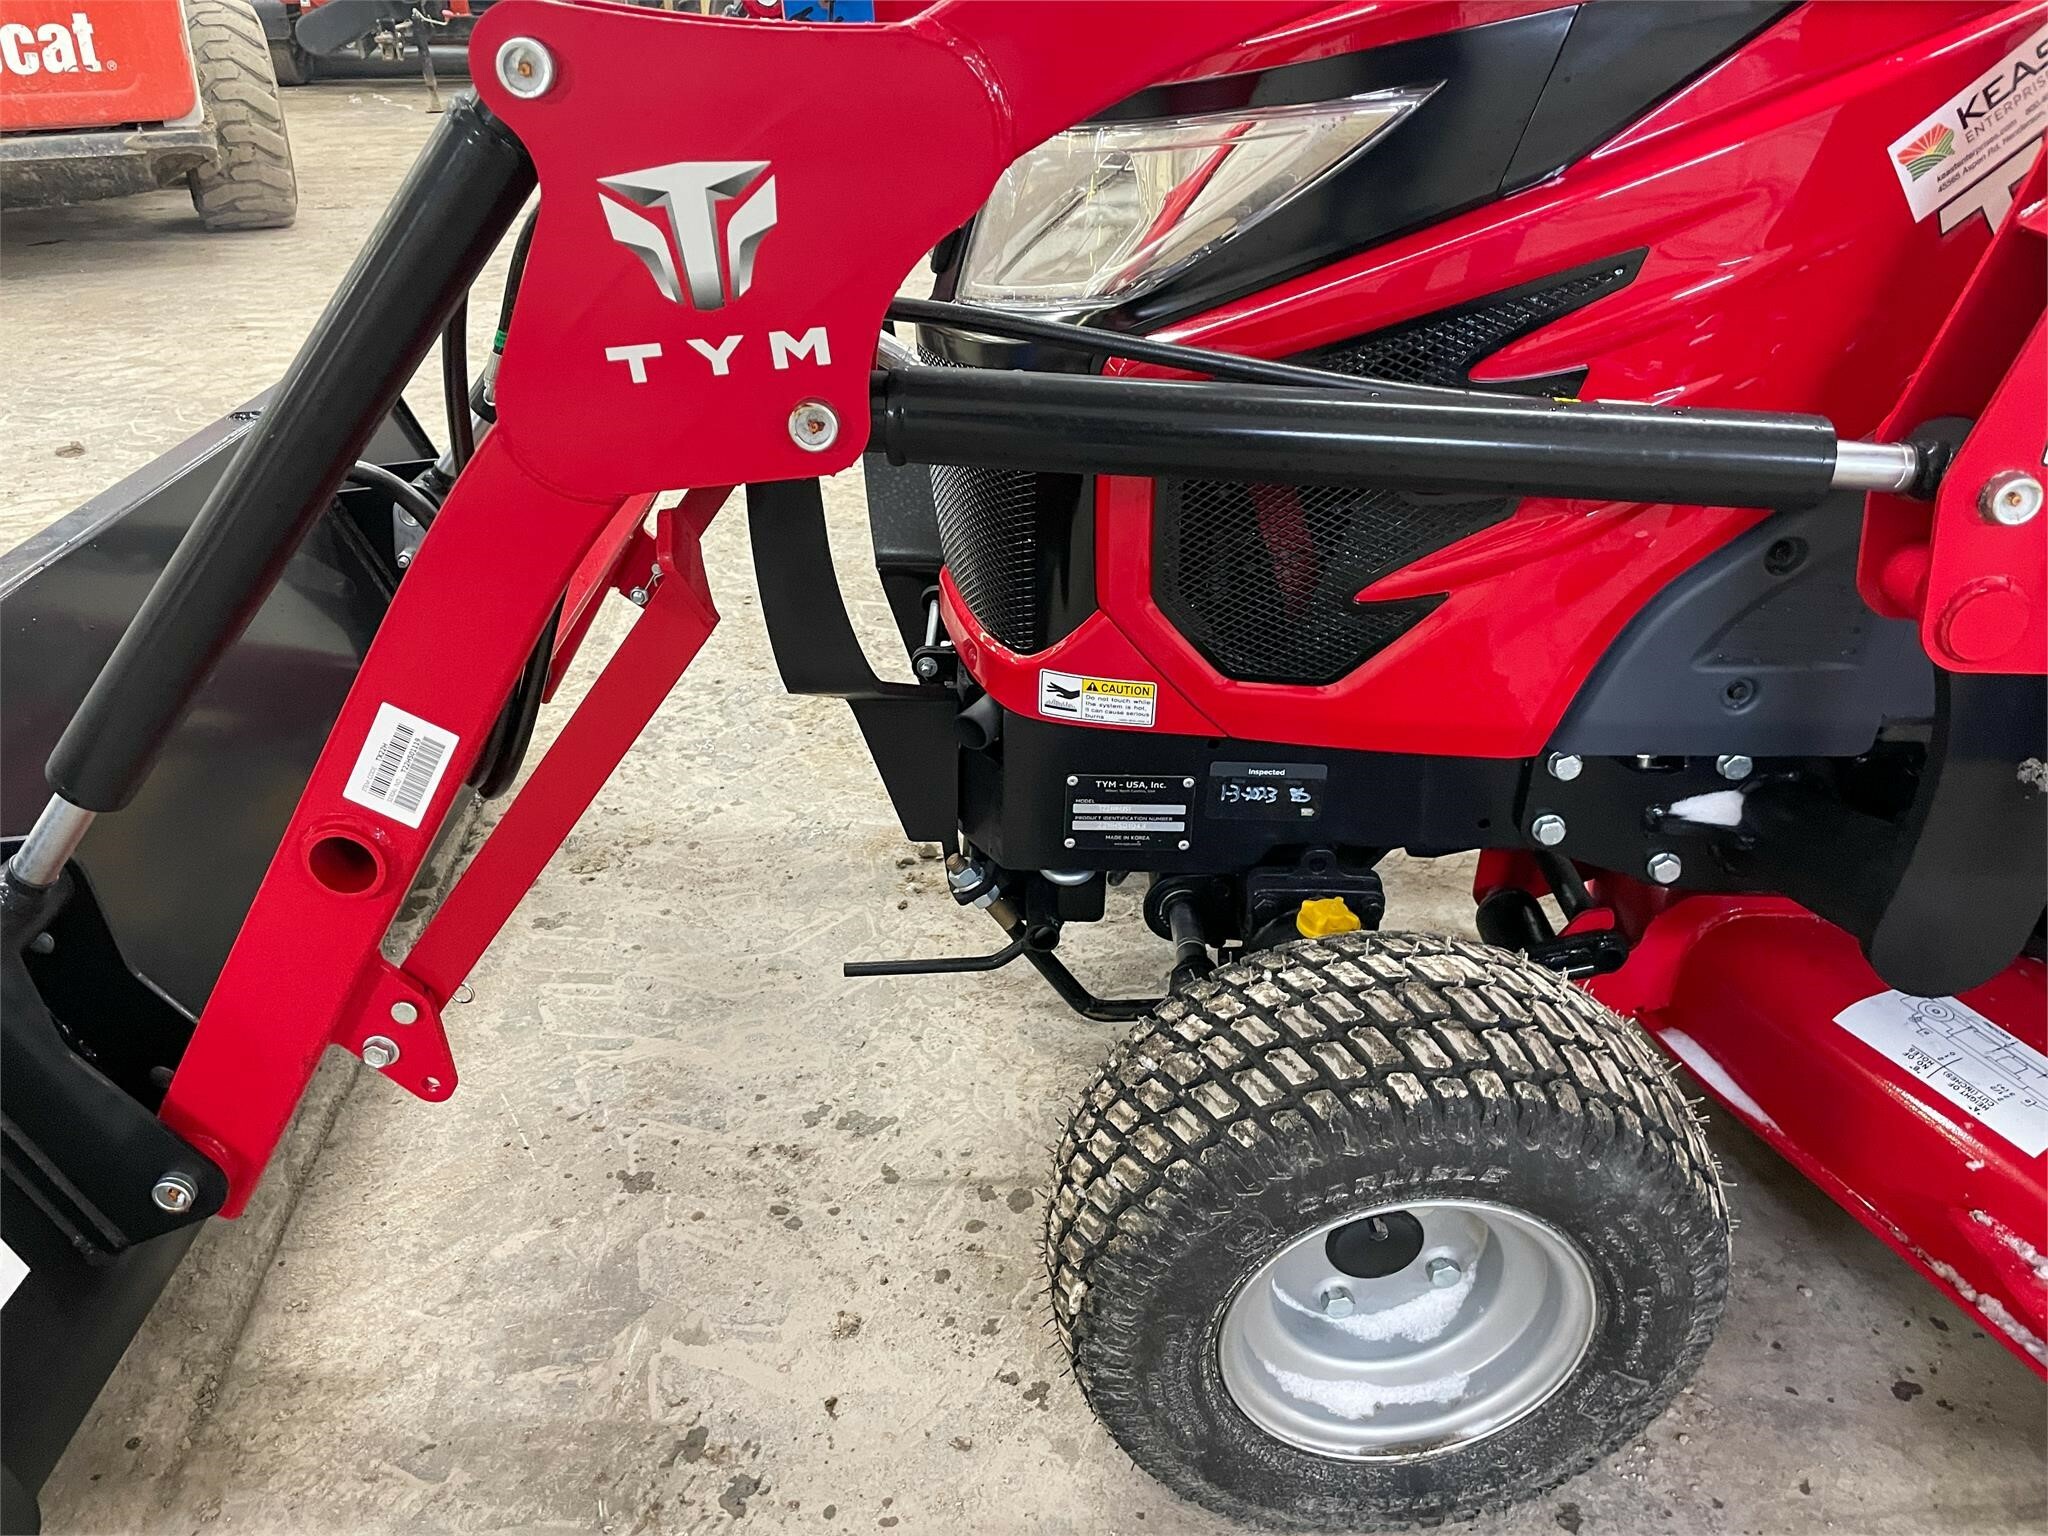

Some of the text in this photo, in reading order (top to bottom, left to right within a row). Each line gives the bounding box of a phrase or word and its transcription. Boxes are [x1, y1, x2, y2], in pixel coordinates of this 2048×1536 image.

[0, 12, 103, 76] cat
[605, 326, 832, 384] TYM
[1101, 683, 1150, 696] CAUTION
[1248, 768, 1286, 777] Inspected
[1095, 780, 1117, 788] TYM
[1126, 781, 1148, 790] USA,
[1150, 781, 1167, 789] Inc.
[1908, 1047, 1935, 1067] HOLES
[1942, 1070, 1978, 1096] (INCHES)
[1946, 1082, 1990, 1111] HEIGHT OF
[1977, 1095, 1995, 1107] CUT
